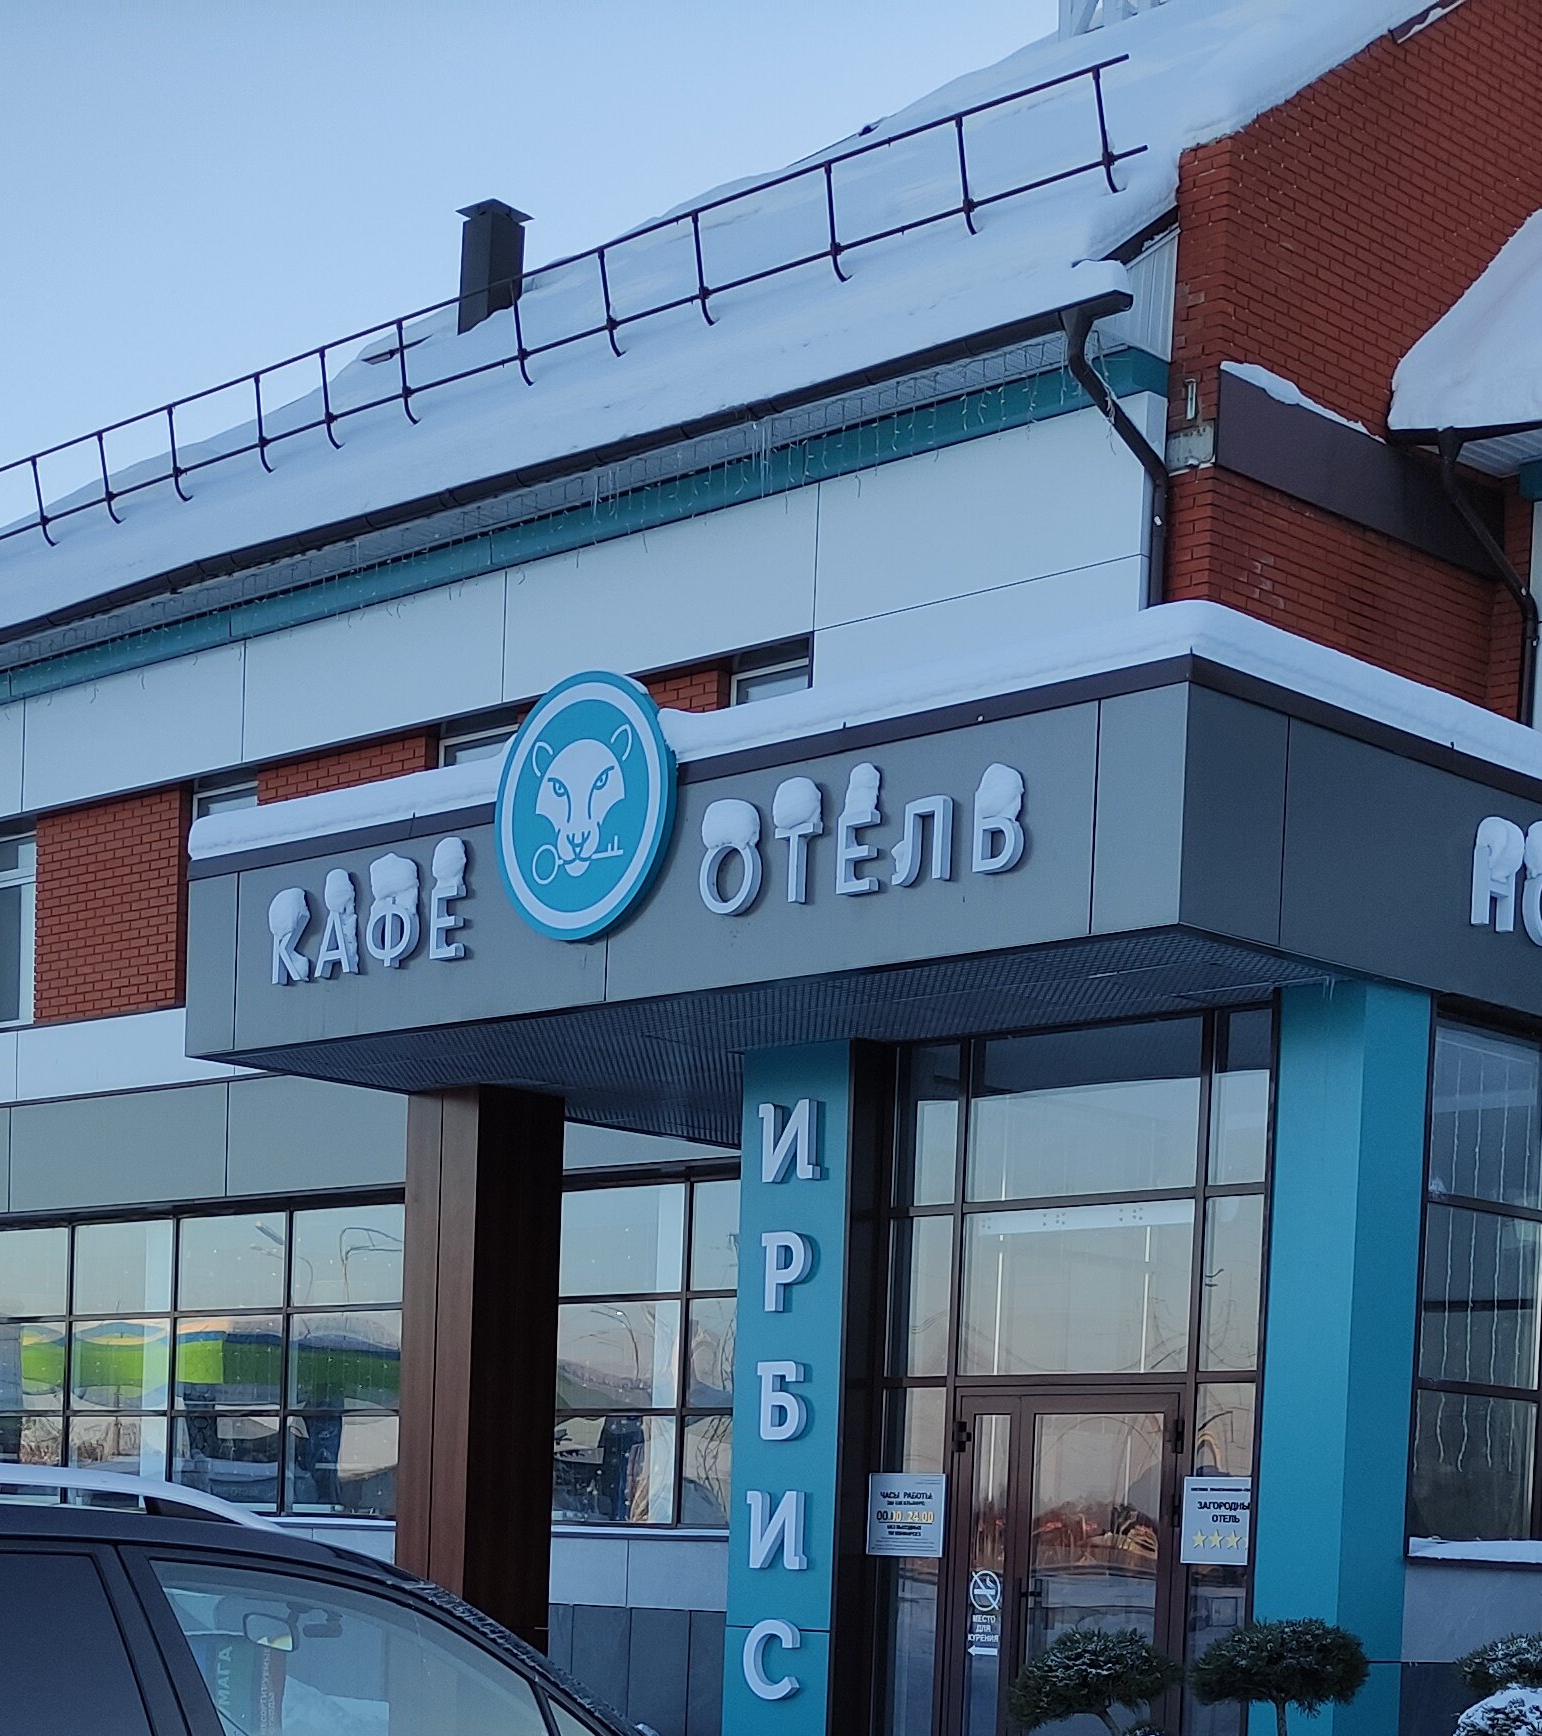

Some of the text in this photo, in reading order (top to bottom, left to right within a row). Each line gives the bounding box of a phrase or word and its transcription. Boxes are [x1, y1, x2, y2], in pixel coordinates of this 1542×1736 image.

[270, 775, 1026, 986] КАФЕ ОТЕЛЬ
[742, 1098, 822, 1701] ИРБИС
[880, 1491, 933, 1500] ЧАСЫ РАБОТЫ
[1197, 1501, 1251, 1511] ЗАГОРОДНЫ
[1211, 1514, 1241, 1523] ОТЕЛЬ
[972, 1614, 996, 1624] МЕСТО
[975, 1624, 992, 1633] ДЛЯ
[967, 1633, 999, 1643] КУРЕНИЯ
